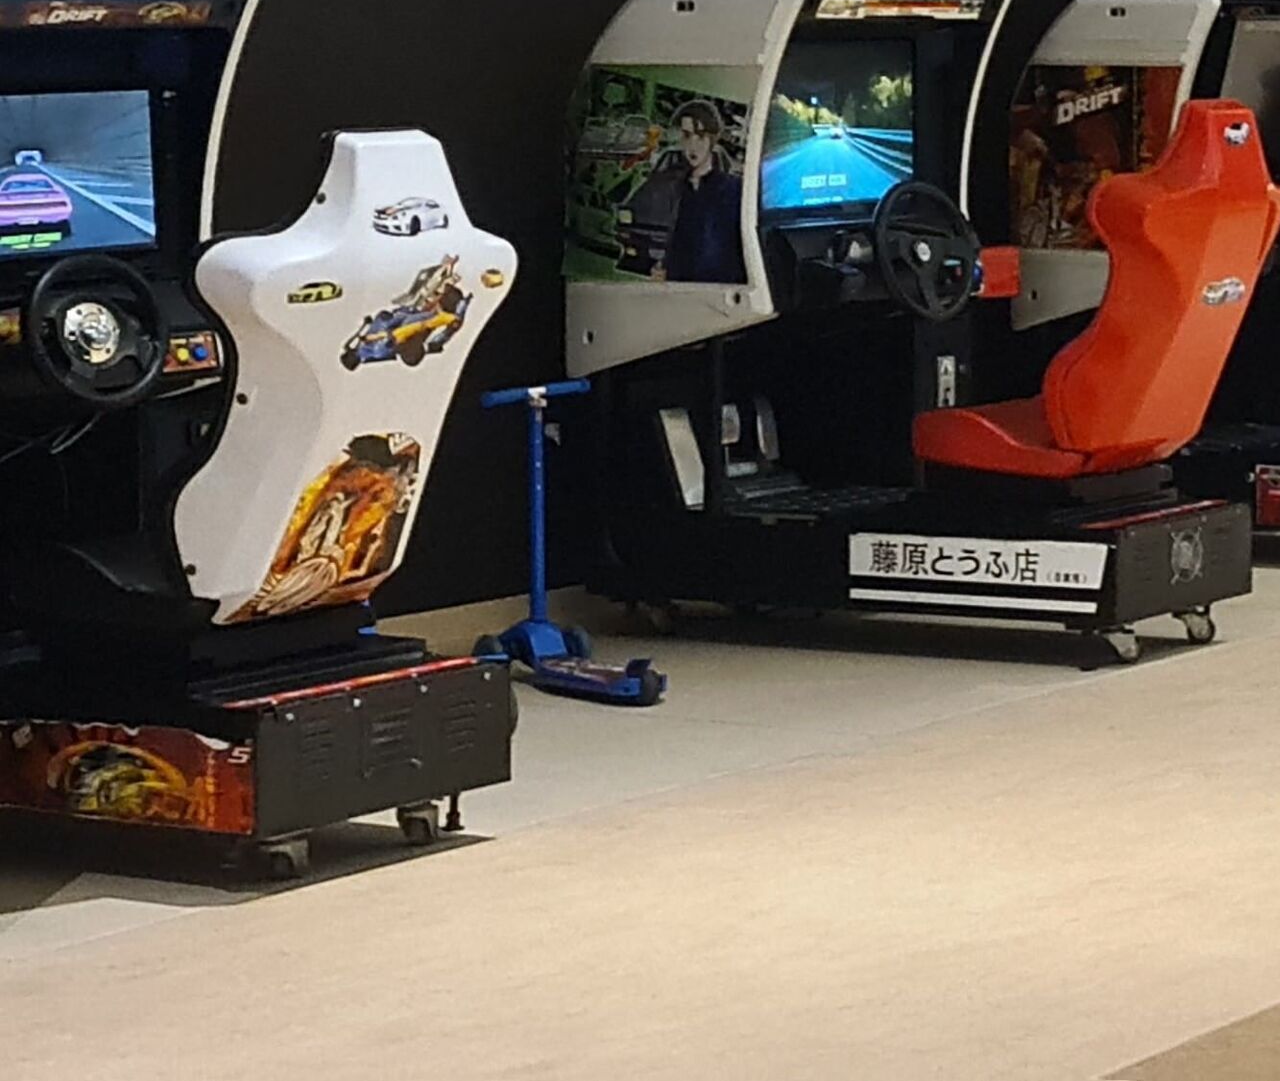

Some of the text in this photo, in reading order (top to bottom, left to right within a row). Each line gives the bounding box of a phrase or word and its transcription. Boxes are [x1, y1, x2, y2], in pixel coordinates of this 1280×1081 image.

[47, 8, 108, 24] DRIFT
[1056, 86, 1125, 126] DRIFT
[869, 540, 1040, 583] 藤原とうふ店
